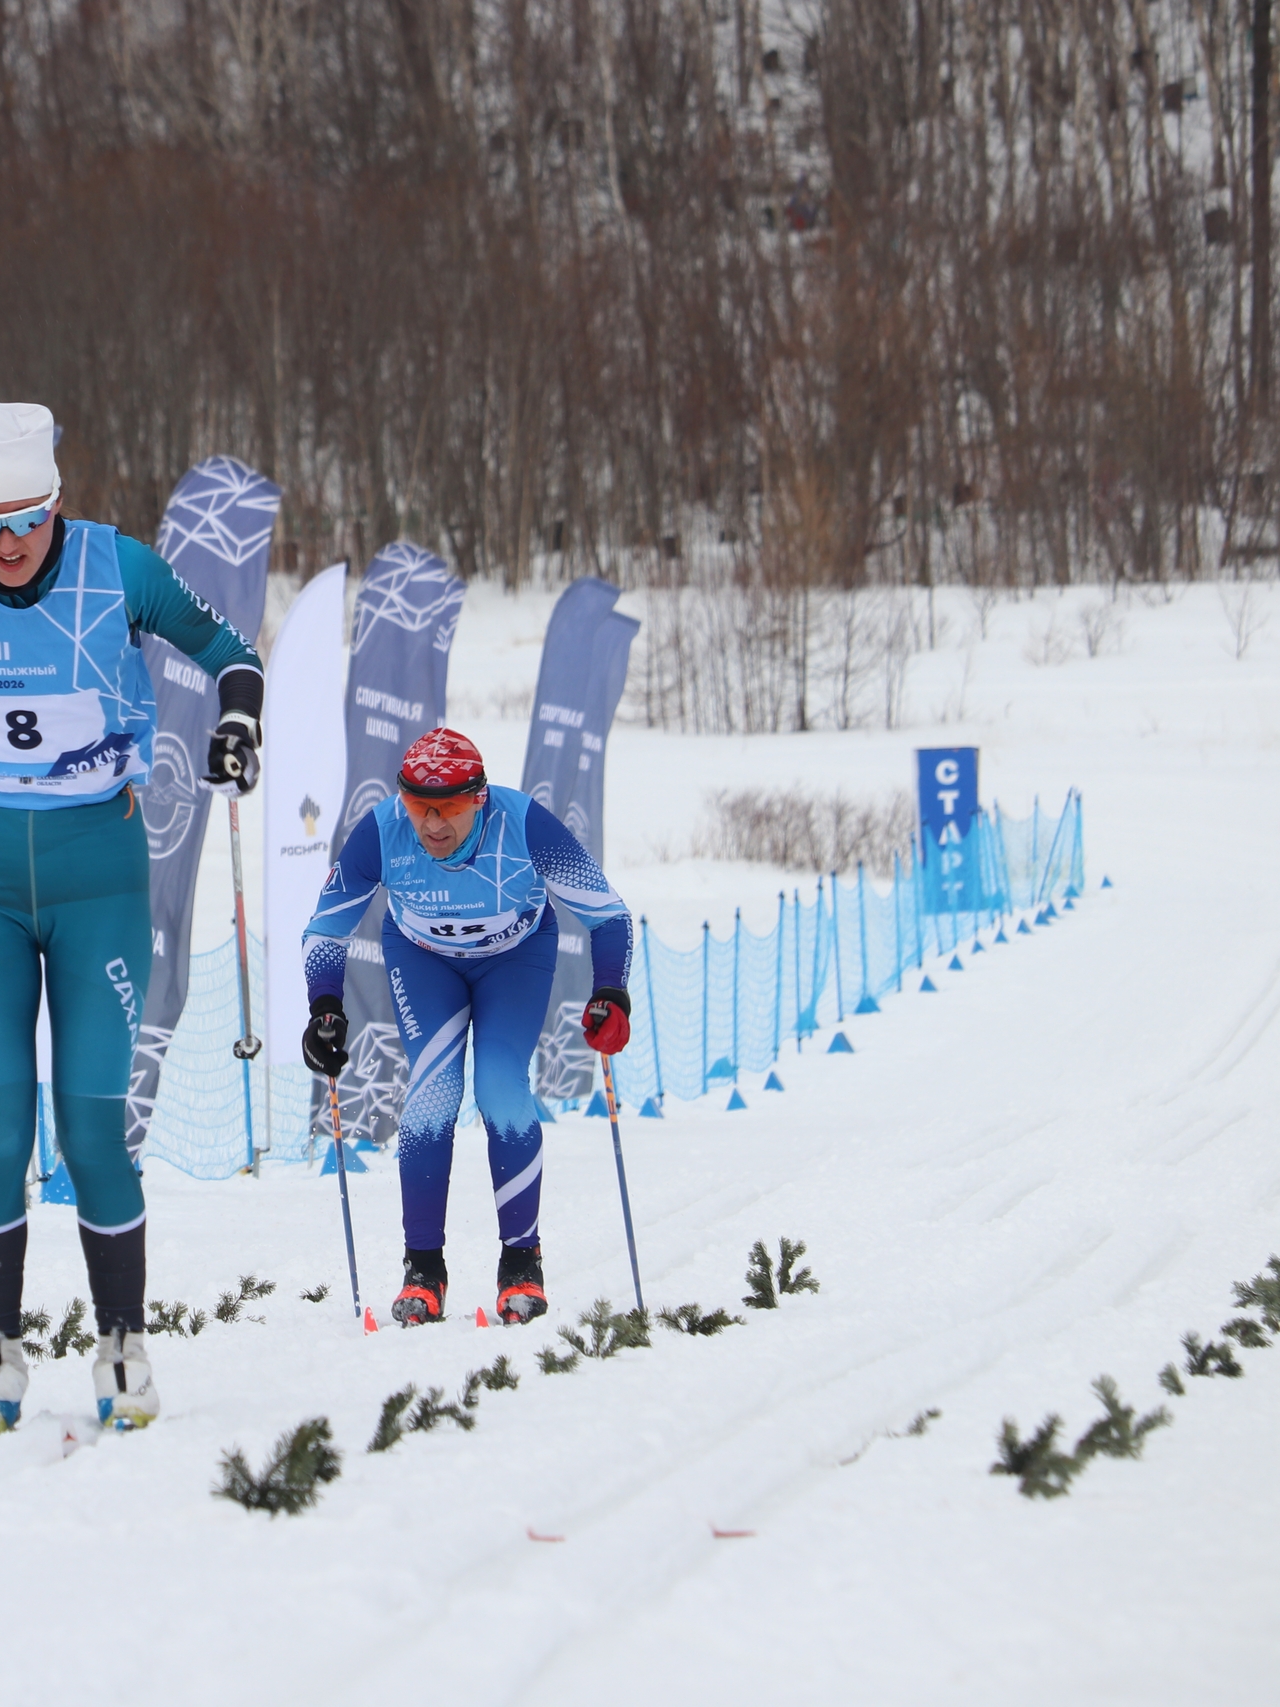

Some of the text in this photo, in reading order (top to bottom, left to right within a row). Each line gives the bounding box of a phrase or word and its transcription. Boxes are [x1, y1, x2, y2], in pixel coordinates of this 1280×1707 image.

[163, 656, 207, 696] ШКОЛА
[355, 686, 424, 722] СПОРТИВНАЯ
[5, 710, 43, 750] 8
[365, 717, 400, 744] ШКОЛА
[66, 760, 90, 775] 30
[93, 747, 120, 768] КМ
[935, 759, 964, 905] СТАРТ
[439, 901, 485, 911] ЛЫЖНЫЙ
[487, 932, 505, 946] 30
[507, 918, 530, 935] КМ
[390, 966, 423, 1041] САХАЛИН
